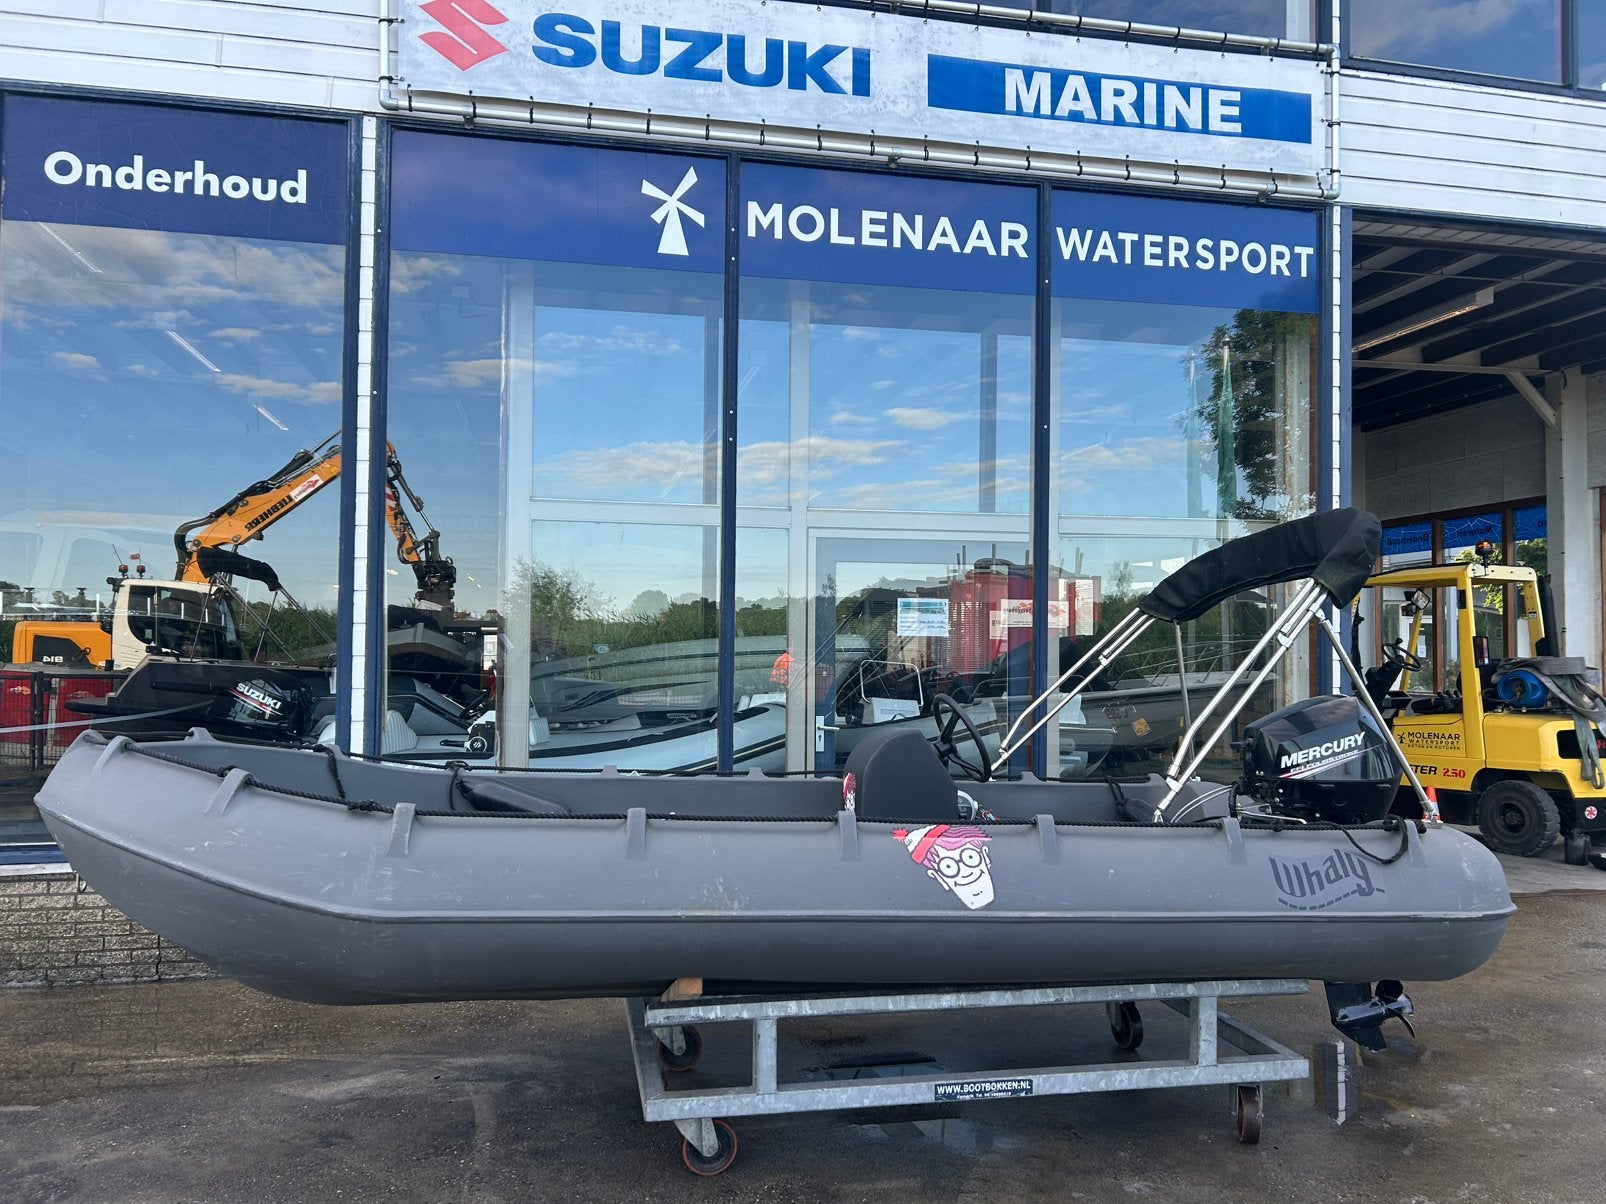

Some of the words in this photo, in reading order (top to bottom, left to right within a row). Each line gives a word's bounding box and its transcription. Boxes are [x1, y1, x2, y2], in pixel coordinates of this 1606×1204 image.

[532, 12, 871, 97] SUZUKI
[1004, 67, 1242, 134] MARINE
[44, 151, 307, 204] Onderhoud
[747, 200, 1029, 259] MOLENAAR
[1055, 226, 1315, 278] WATERSPORT
[236, 682, 281, 709] SUZUKI
[1280, 731, 1366, 769] MERCURY
[1407, 731, 1460, 740] MOLENAAR
[1268, 848, 1375, 898] Whaly
[936, 1080, 1031, 1095] WWW.BOOTBOKKEN.NL
